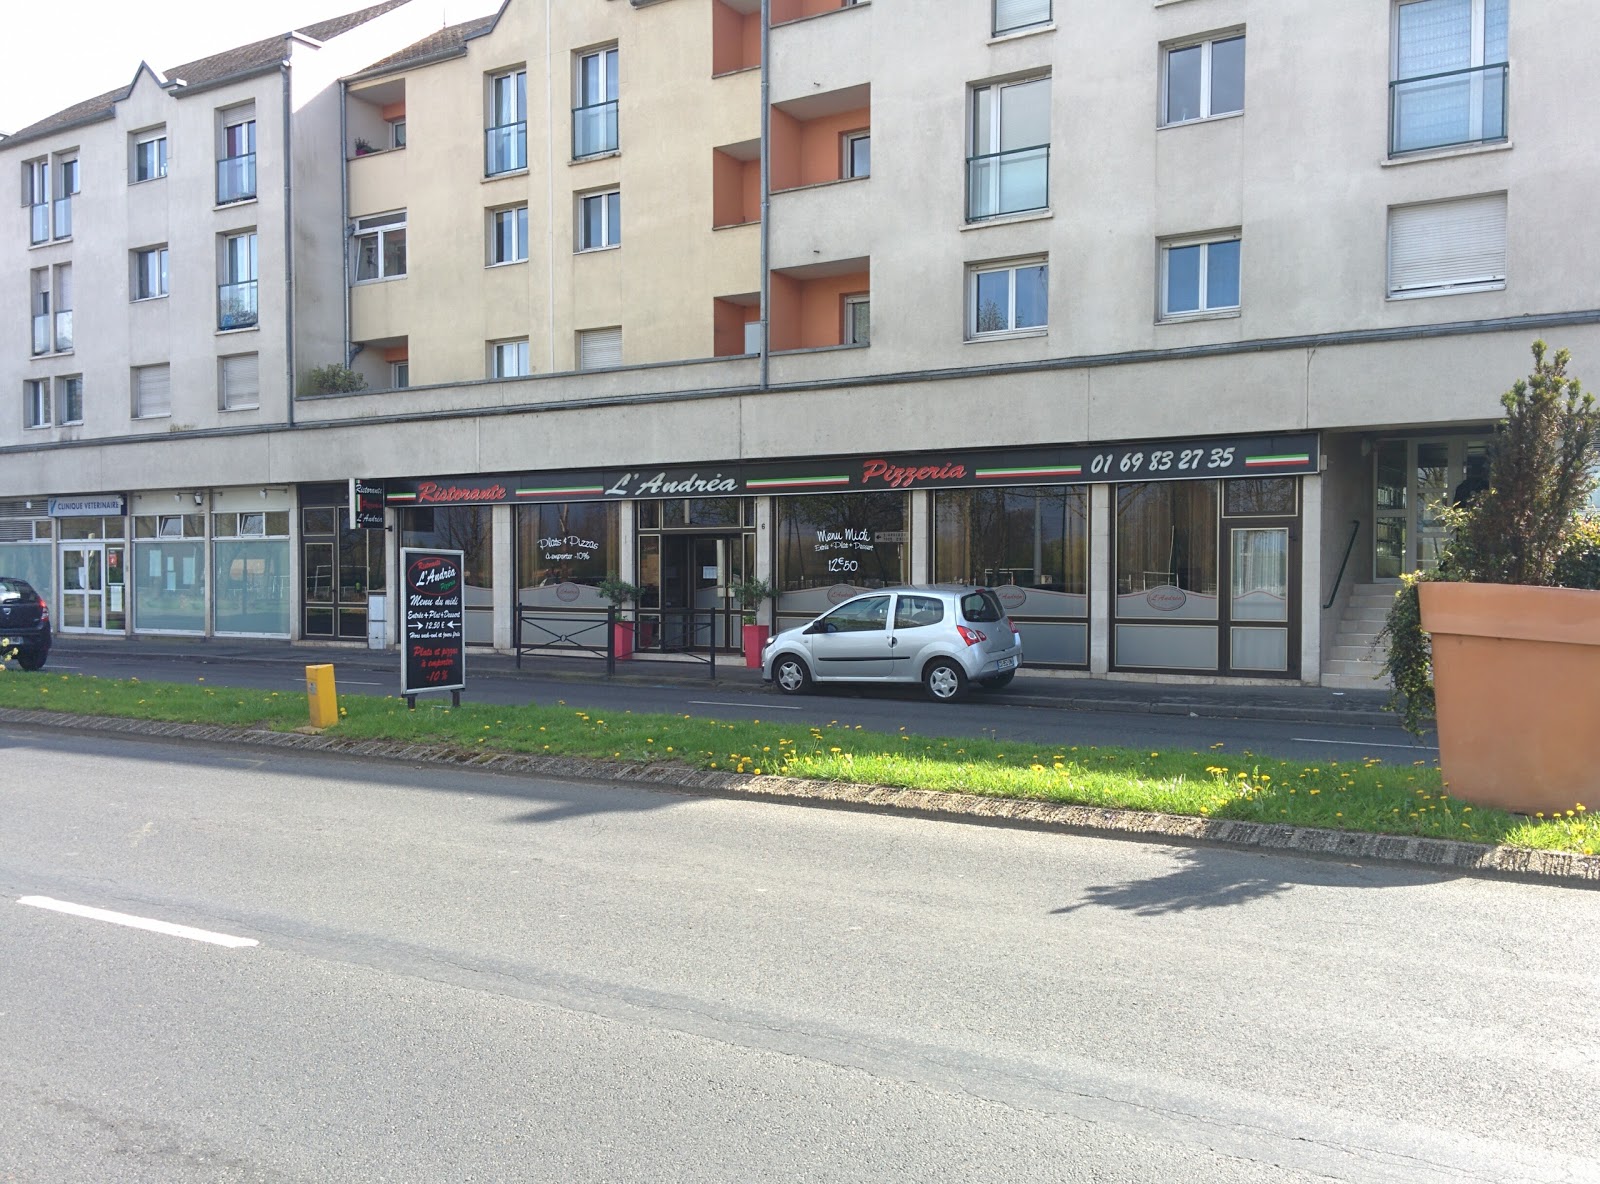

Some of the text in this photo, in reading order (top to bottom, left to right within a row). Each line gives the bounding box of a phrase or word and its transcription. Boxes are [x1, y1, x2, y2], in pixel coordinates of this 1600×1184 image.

[1091, 447, 1236, 474] 01 69 83 27 35
[862, 459, 968, 489] Pizzeria
[605, 471, 739, 496] L'Andréa
[418, 481, 507, 504] Ristorante
[57, 502, 83, 510] CLINIQUE
[761, 522, 766, 530] 6
[537, 537, 562, 550] Plats
[567, 535, 599, 549] Pizzas
[816, 530, 843, 543] Menu
[844, 528, 871, 542] Midi
[416, 565, 457, 586] L'Andréa
[410, 594, 459, 606] Menu du midi
[413, 645, 433, 657] Plats
